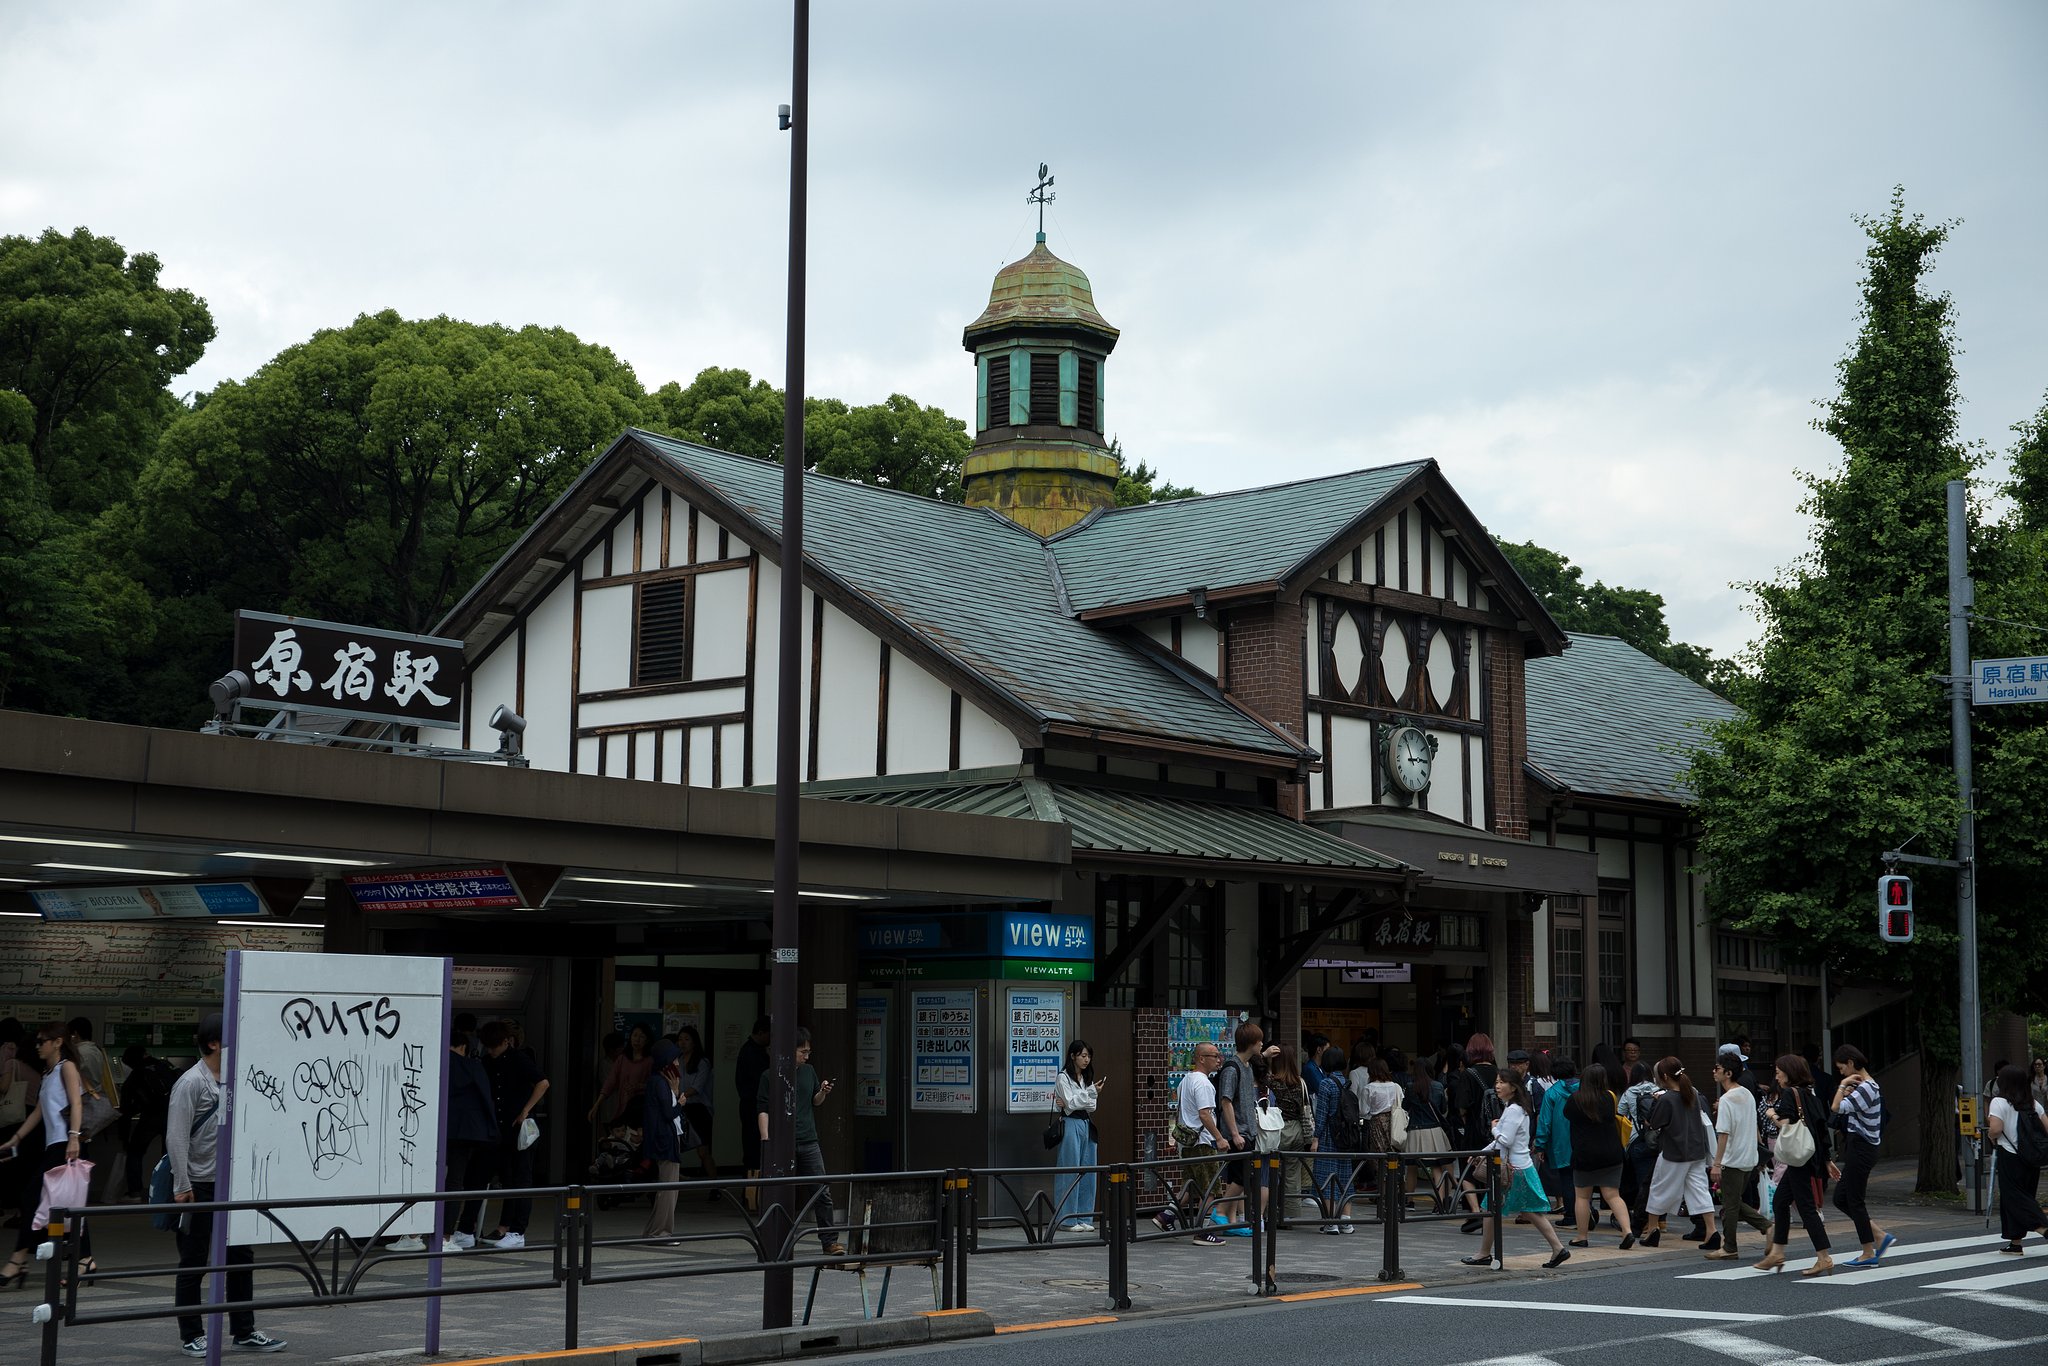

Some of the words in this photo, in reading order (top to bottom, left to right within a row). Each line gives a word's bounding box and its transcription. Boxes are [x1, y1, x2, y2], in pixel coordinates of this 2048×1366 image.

[251, 628, 452, 707] 原宿駅
[1983, 664, 2048, 684] 原宿駅
[1989, 686, 2037, 699] Harajuku
[382, 881, 483, 900] ハリウッド大学院大学
[88, 895, 140, 906] BIODERMA
[1065, 926, 1085, 939] ATM
[1375, 917, 1433, 946] 原宿駅
[1064, 938, 1087, 948] コーナー
[1024, 966, 1048, 974] VIEW
[1048, 967, 1073, 975] ALTTE
[493, 979, 514, 987] Suica
[281, 996, 401, 1041] PUTS
[919, 1010, 937, 1021] 銀行
[942, 1010, 969, 1022] ゆうちょ
[1014, 1011, 1030, 1021] 銀行
[1035, 1011, 1058, 1022] ゆうちょ
[948, 1027, 970, 1036] ろうきん
[1013, 1028, 1024, 1036] 信金
[1041, 1028, 1059, 1036] ろうきん
[917, 1039, 970, 1053] 引き出しOK
[1012, 1039, 1060, 1053] 引き出しOK
[924, 1092, 955, 1103] 足利銀行
[1019, 1092, 1046, 1103] 足利銀行
